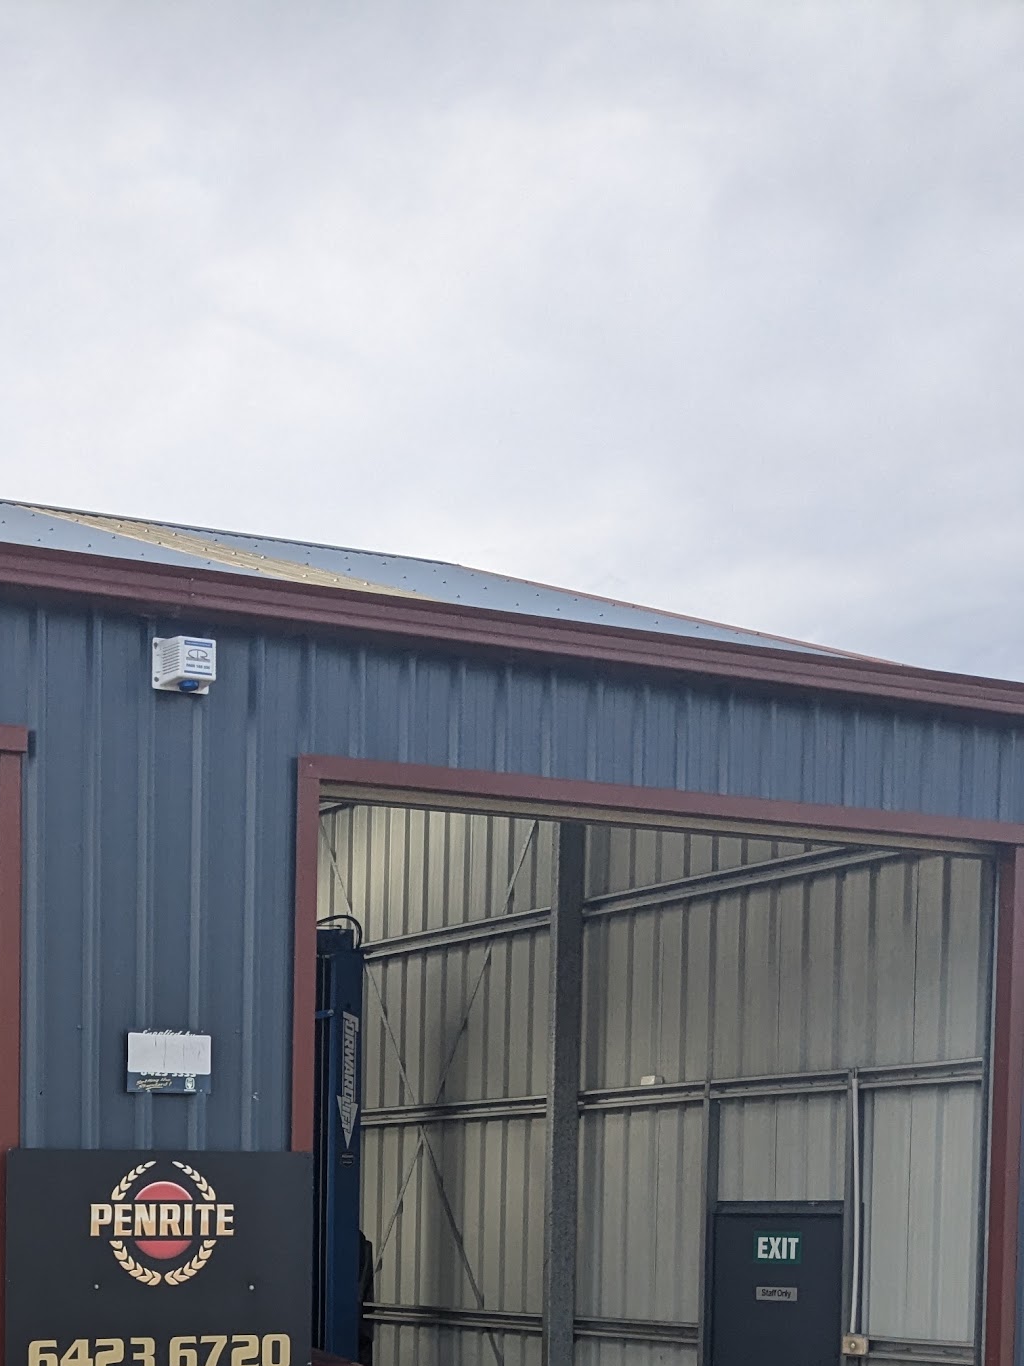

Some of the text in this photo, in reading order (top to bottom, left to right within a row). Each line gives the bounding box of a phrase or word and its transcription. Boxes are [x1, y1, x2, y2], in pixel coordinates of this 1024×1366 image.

[89, 1203, 235, 1237] PENRITE
[757, 1236, 799, 1260] EXIT
[761, 1288, 792, 1299] Staff Only
